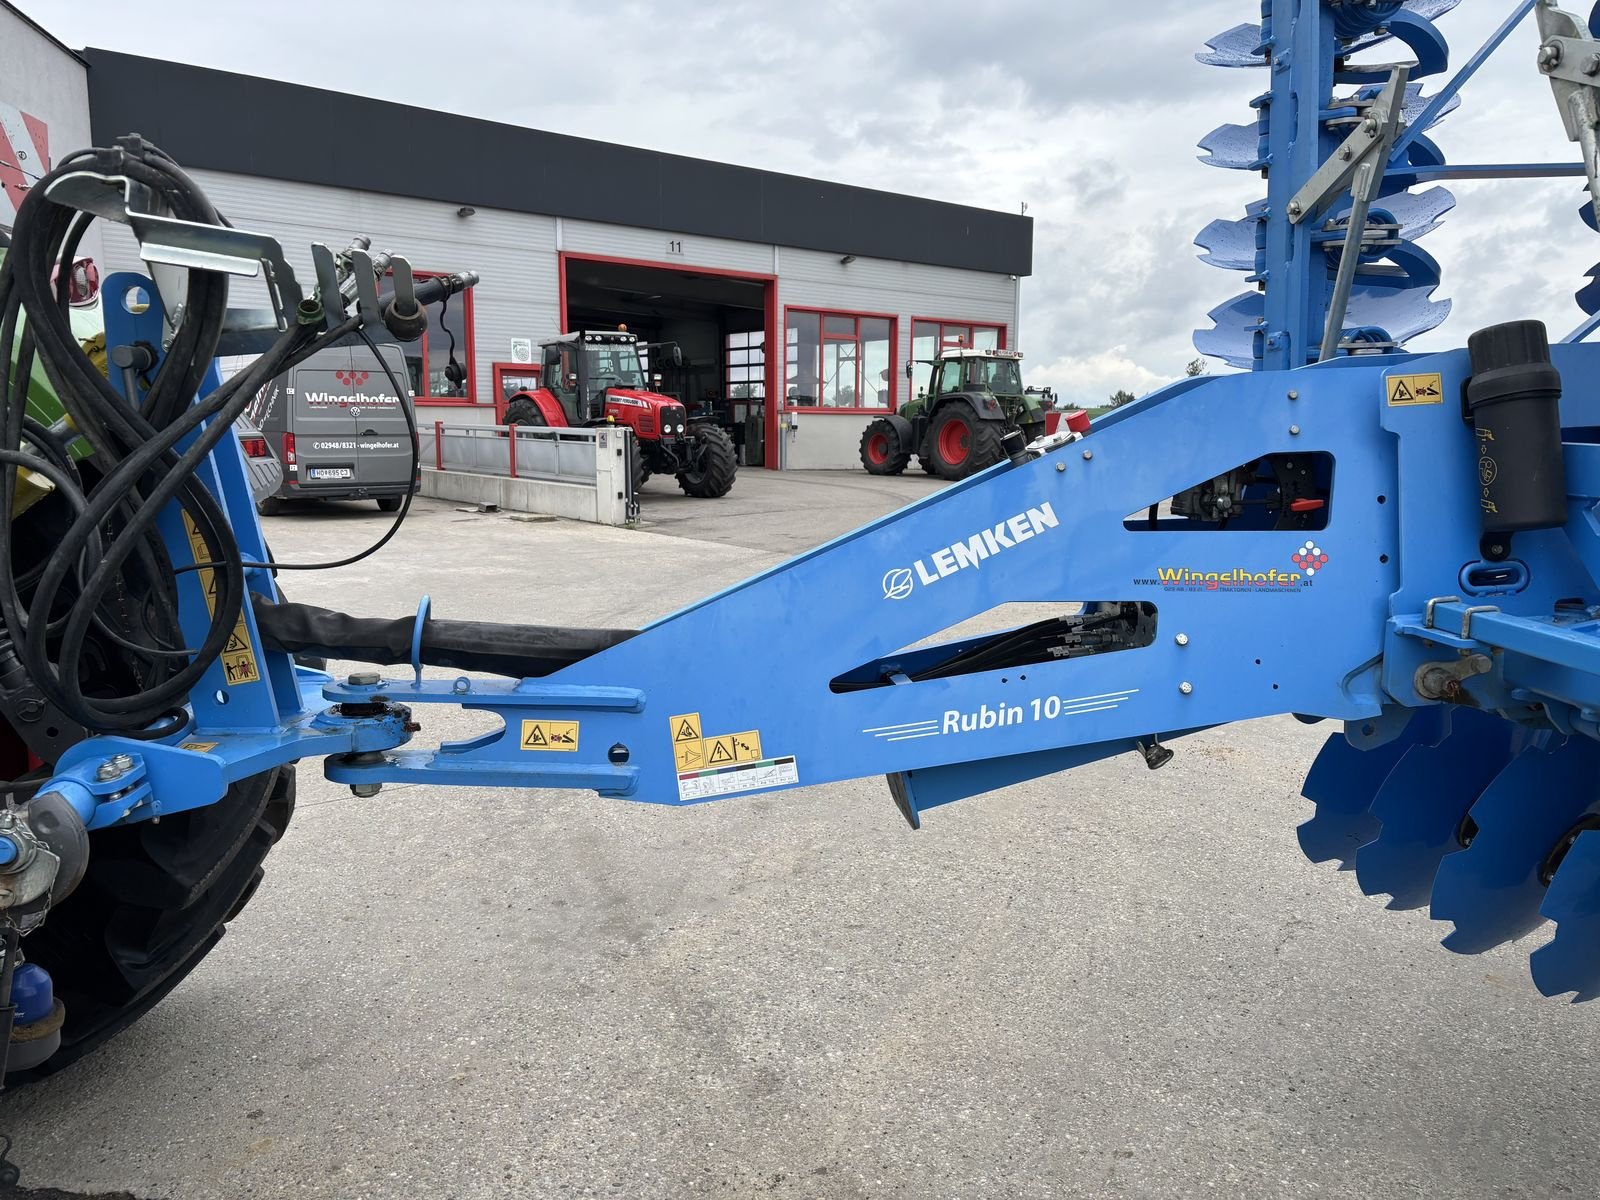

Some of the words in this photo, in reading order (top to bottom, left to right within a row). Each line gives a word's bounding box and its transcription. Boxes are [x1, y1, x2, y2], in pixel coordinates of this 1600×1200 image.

[669, 240, 681, 253] 11
[304, 392, 400, 408] Wingelhofer
[360, 442, 399, 450] wingelhofer.at
[913, 501, 1060, 586] LEMKEN
[942, 702, 1024, 735] Rubin
[1030, 695, 1061, 721] 10
